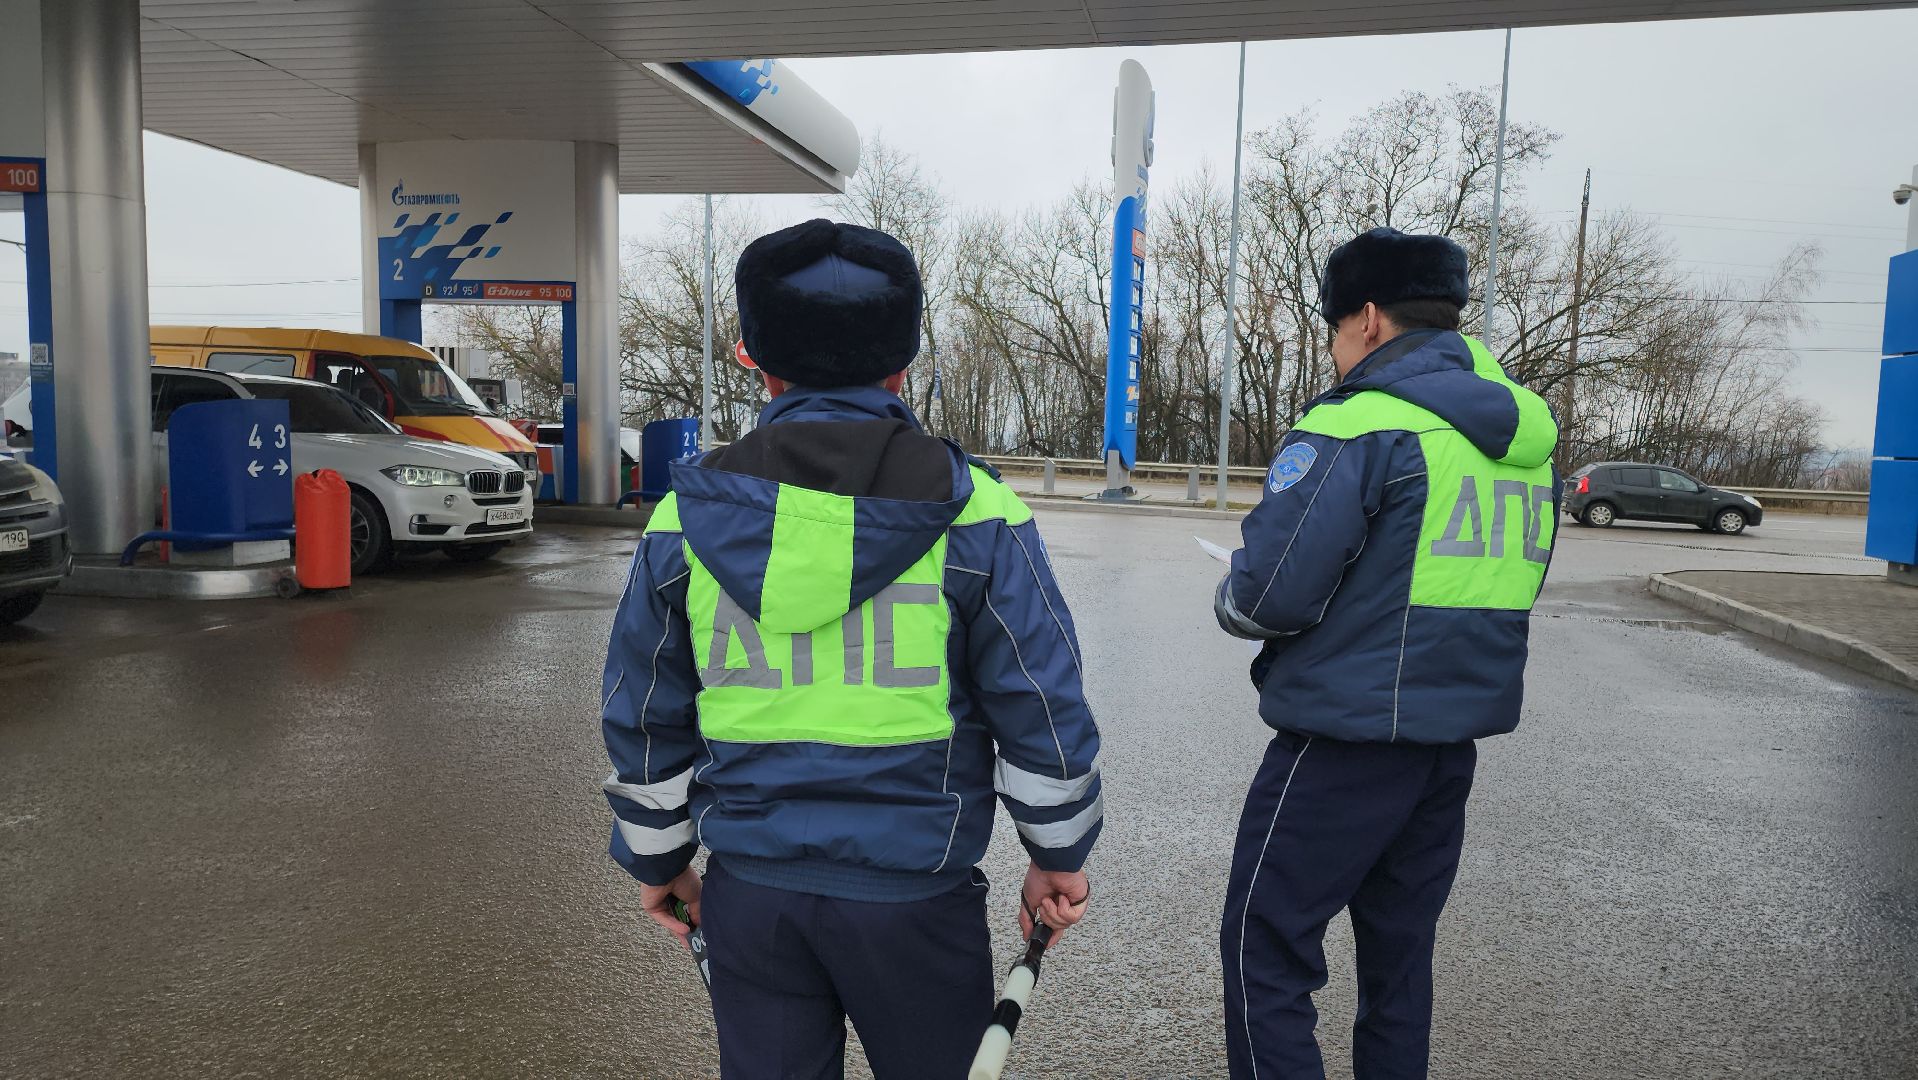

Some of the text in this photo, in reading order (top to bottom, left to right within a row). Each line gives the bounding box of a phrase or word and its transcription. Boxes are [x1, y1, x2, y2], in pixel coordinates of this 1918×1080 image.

[8, 169, 37, 186] 100
[404, 193, 460, 205] ГАЗПРОМНЕФТЬ
[393, 258, 404, 281] 2
[425, 285, 432, 296] D
[442, 286, 453, 296] 92
[462, 286, 473, 296] 95
[539, 287, 551, 297] 95
[556, 288, 572, 298] 100
[248, 424, 286, 449] 4 3
[683, 432, 698, 447] 2 1
[1431, 475, 1553, 565] ДПС
